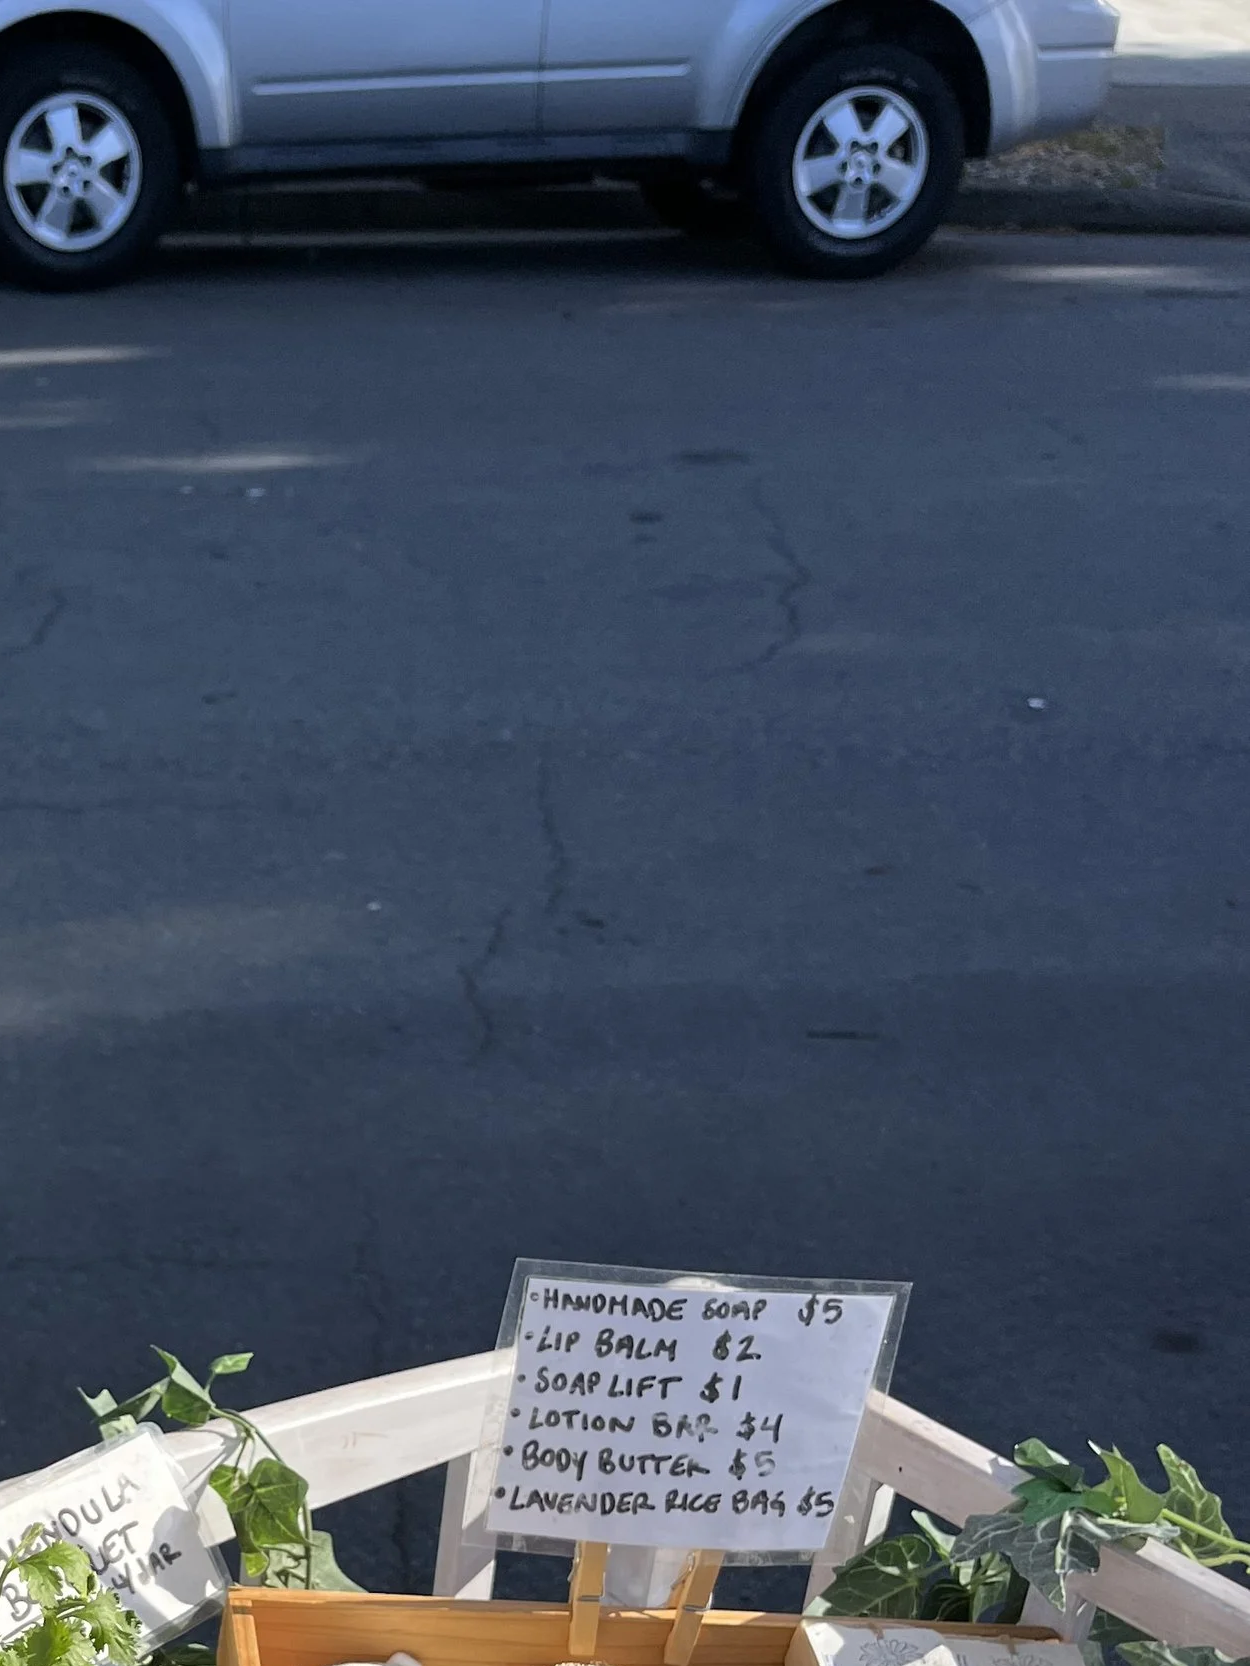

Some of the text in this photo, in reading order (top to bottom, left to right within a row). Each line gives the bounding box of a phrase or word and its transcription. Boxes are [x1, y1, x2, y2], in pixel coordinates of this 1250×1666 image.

[543, 1287, 844, 1326] HANDMADE SOAP $5
[536, 1325, 762, 1362] LIP BALM $2
[534, 1365, 742, 1403] SOAP LIFT $1
[528, 1406, 783, 1444] LOTION BAR $4
[521, 1439, 776, 1481] BODY BUTTER $5
[509, 1485, 834, 1518] LAVENDER RICE BAG $5
[3, 1520, 138, 1622] BUET
